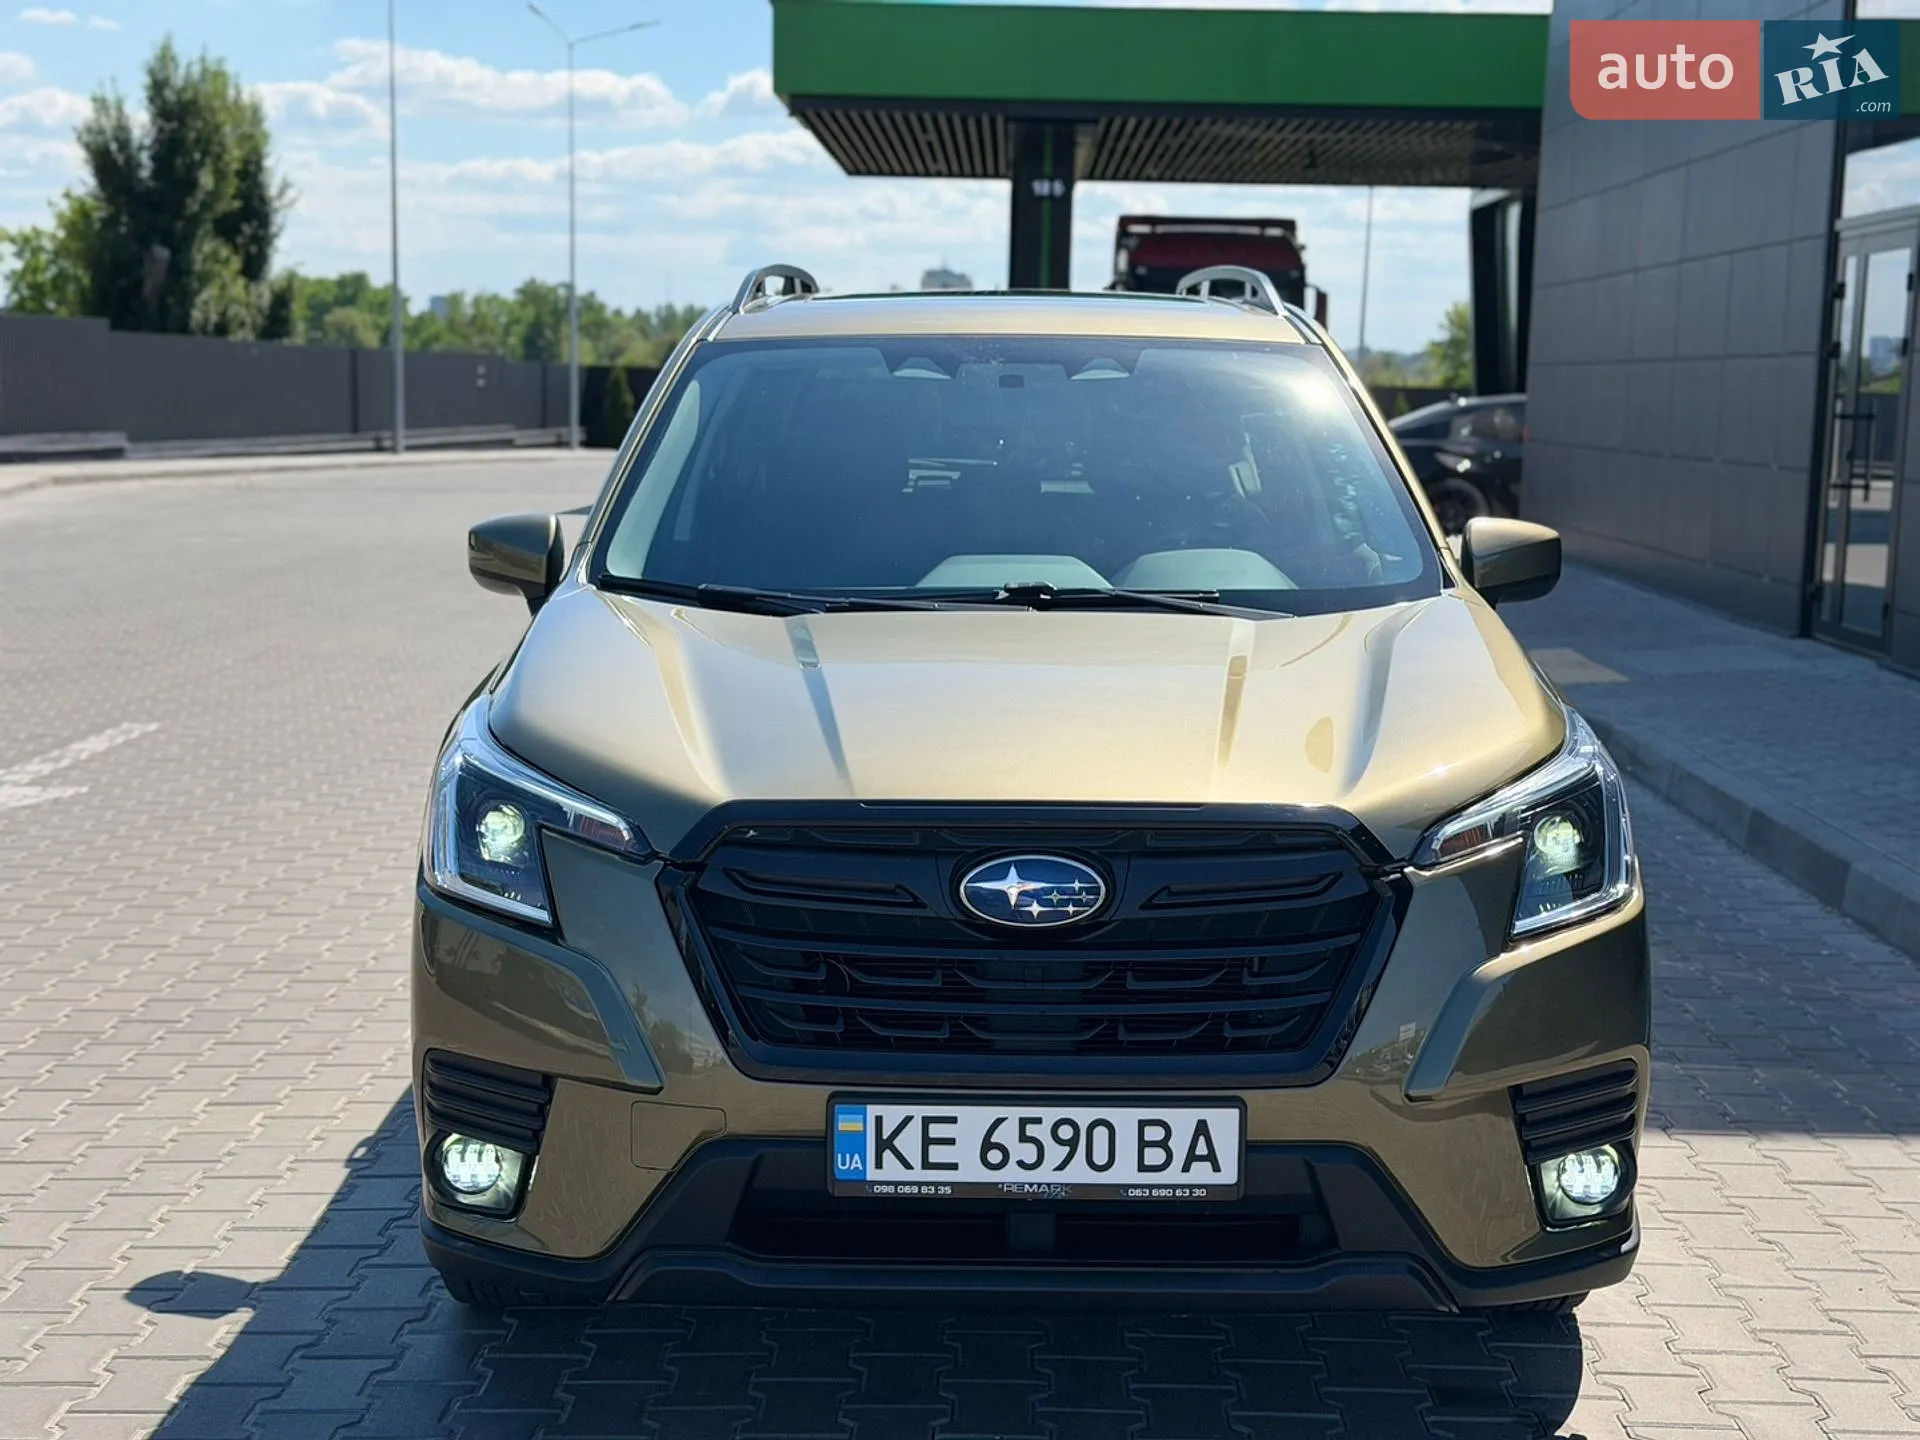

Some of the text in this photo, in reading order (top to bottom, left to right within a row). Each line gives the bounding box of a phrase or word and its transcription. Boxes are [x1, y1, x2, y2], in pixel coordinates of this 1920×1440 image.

[874, 1115, 1222, 1173] KE 6590 BA
[837, 1153, 863, 1171] UA
[1003, 1183, 1072, 1194] REMARK
